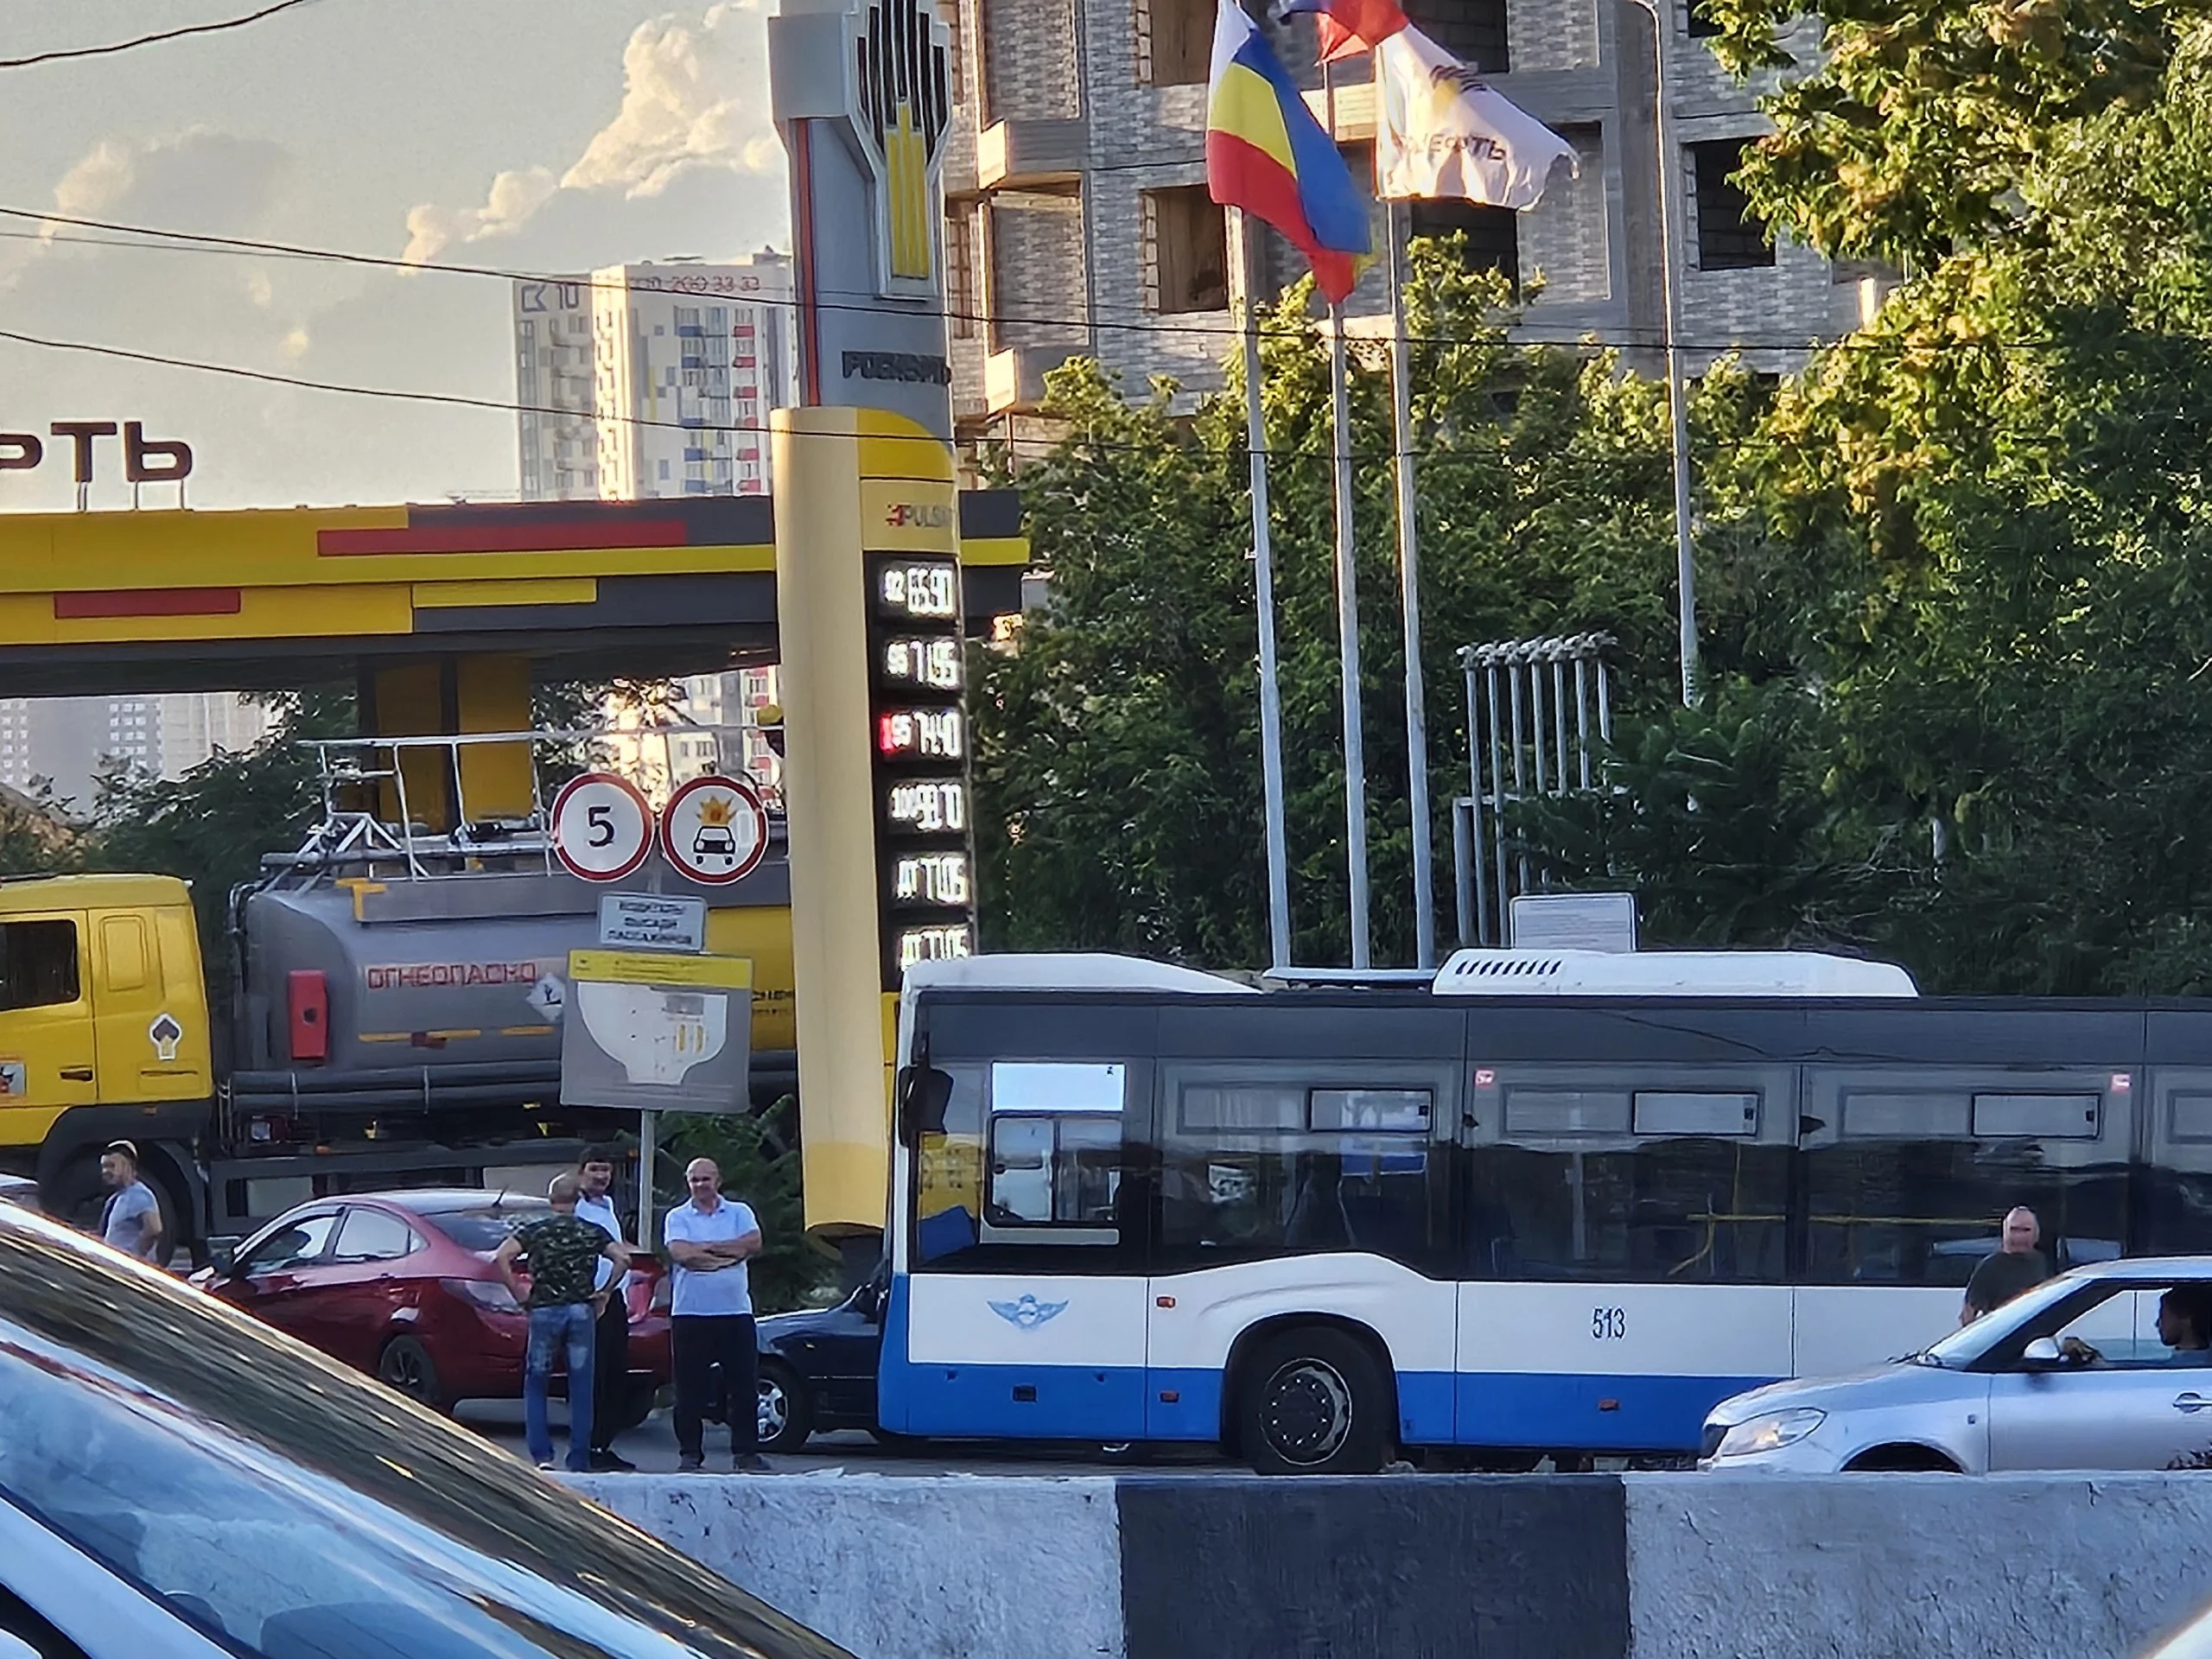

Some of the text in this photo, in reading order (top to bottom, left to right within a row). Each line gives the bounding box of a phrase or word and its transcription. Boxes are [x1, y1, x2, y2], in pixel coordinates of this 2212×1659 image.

[588, 805, 615, 848] 5
[368, 962, 537, 989] ОГНЕОПАСНО
[1592, 1306, 1625, 1339] 513
